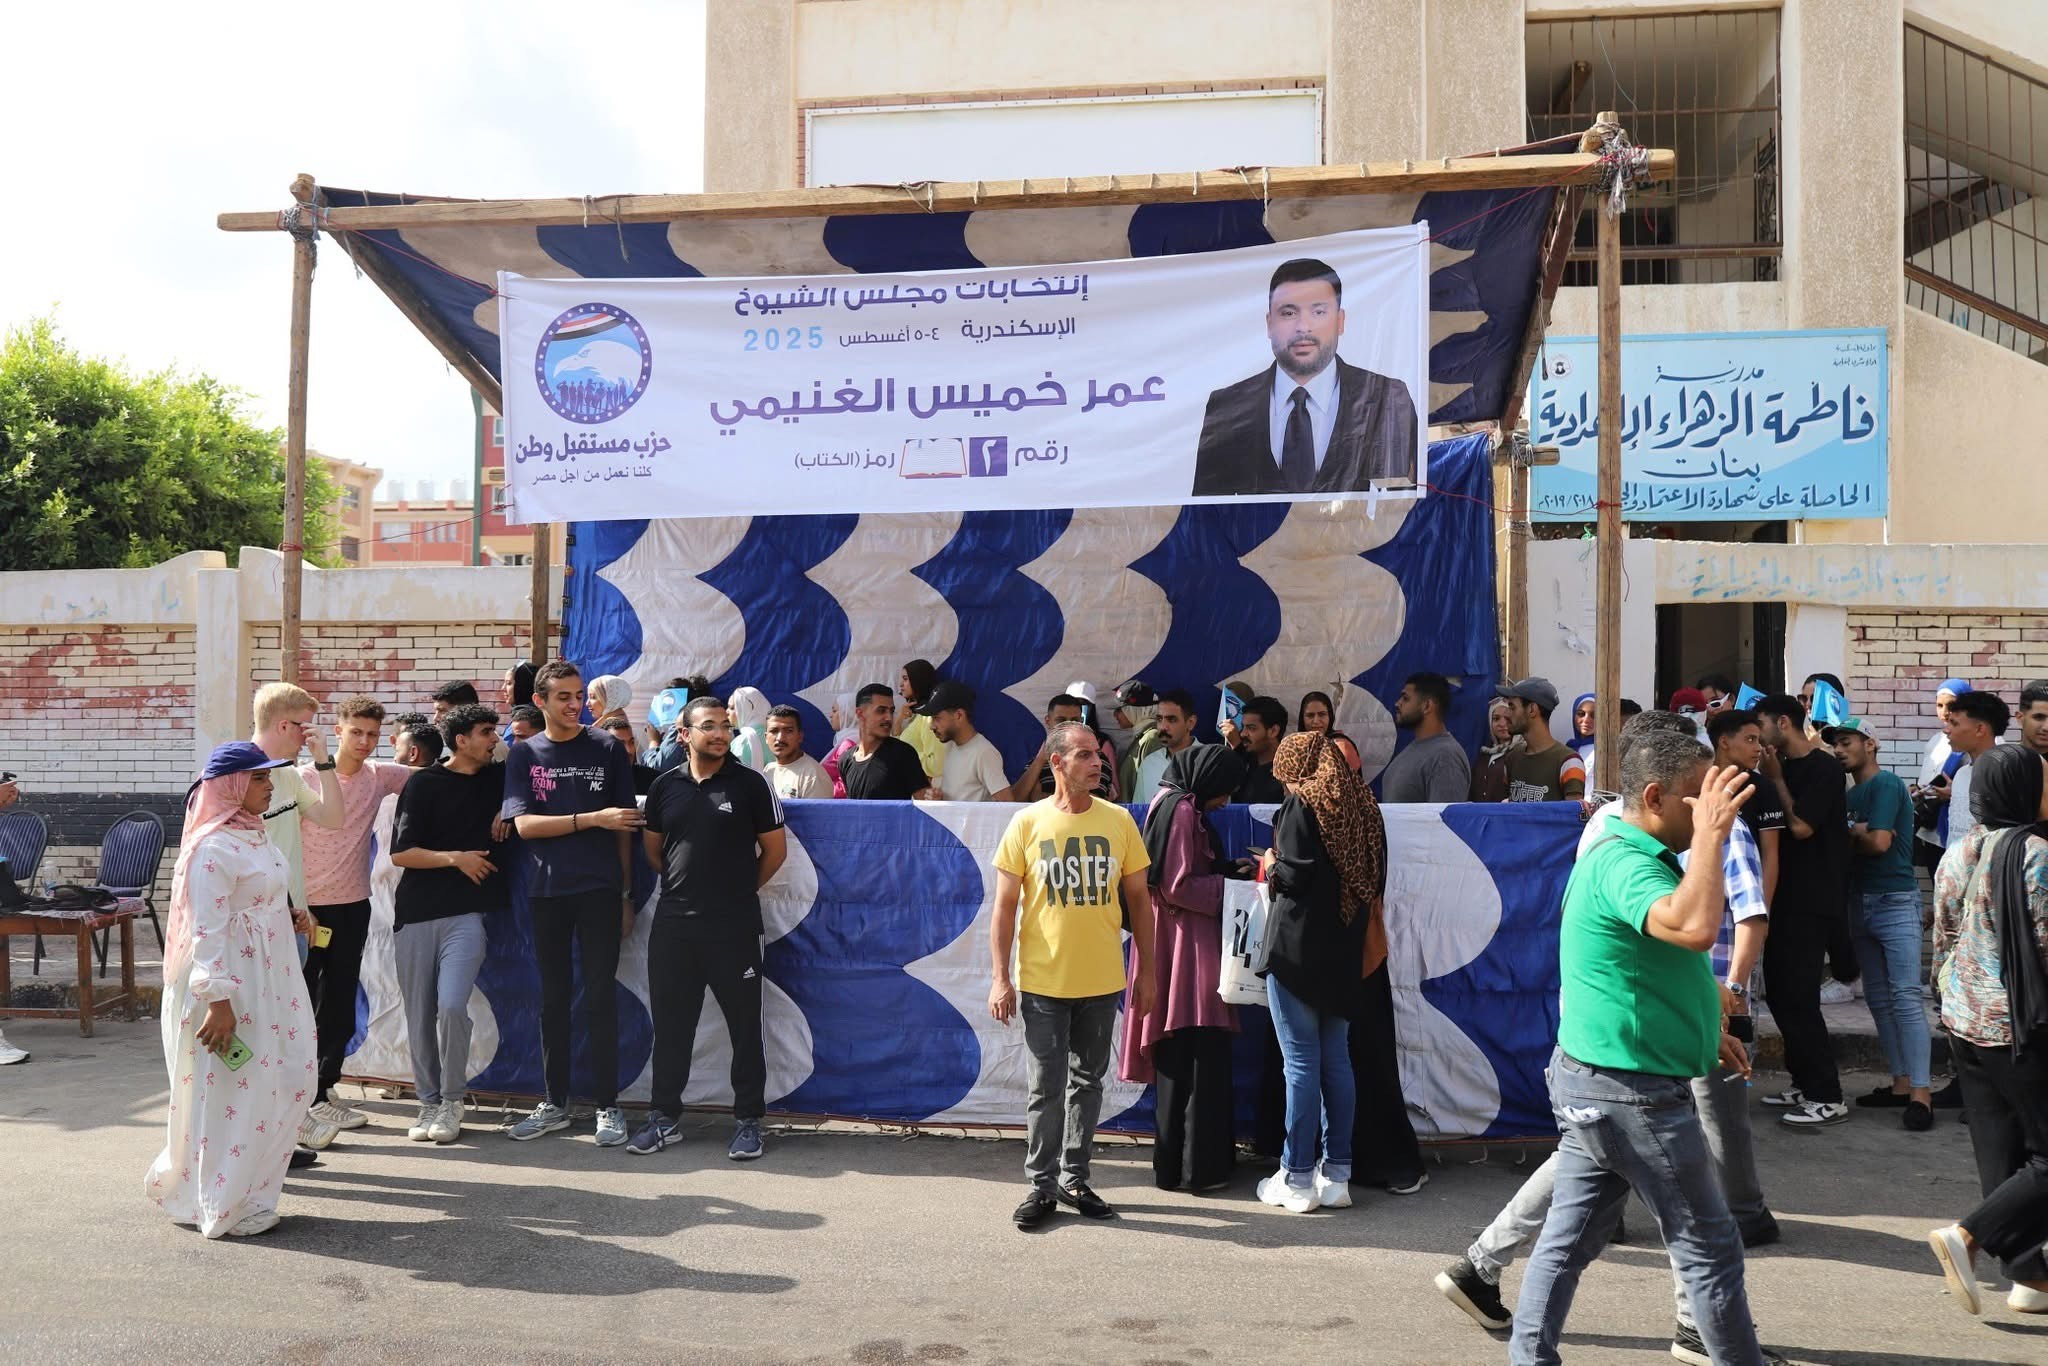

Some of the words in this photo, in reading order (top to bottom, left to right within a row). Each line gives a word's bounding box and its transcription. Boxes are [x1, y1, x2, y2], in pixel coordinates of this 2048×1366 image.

[734, 284, 836, 316] الشيوخ
[843, 285, 947, 311] مجلس
[956, 274, 1089, 304] إنتخابات
[743, 325, 823, 351] 2025
[839, 325, 910, 347] أغسطس
[961, 317, 1075, 343] الإسكندرية
[1655, 361, 1764, 384] مدرسة
[709, 377, 895, 436] الغنيمي
[907, 371, 1067, 419] خميس
[1081, 376, 1166, 413] عمر
[1538, 389, 1652, 451] الإدادية
[1650, 386, 1753, 449] الزهراء
[1763, 381, 1874, 444] فاطمة
[515, 434, 553, 464] وطن
[556, 432, 630, 462] مستقبل
[632, 431, 672, 460] حزب
[1014, 440, 1068, 467] رقم
[632, 465, 652, 478] كلنا
[863, 451, 896, 469] رمز
[1641, 448, 1761, 483] بنات
[532, 474, 557, 486] مصر
[583, 470, 600, 483] من
[603, 467, 629, 481] نعمل
[1707, 484, 1760, 511] شهادة
[1758, 485, 1794, 510] على
[1799, 483, 1870, 508] الحاصلة
[1510, 788, 1544, 803] UPER
